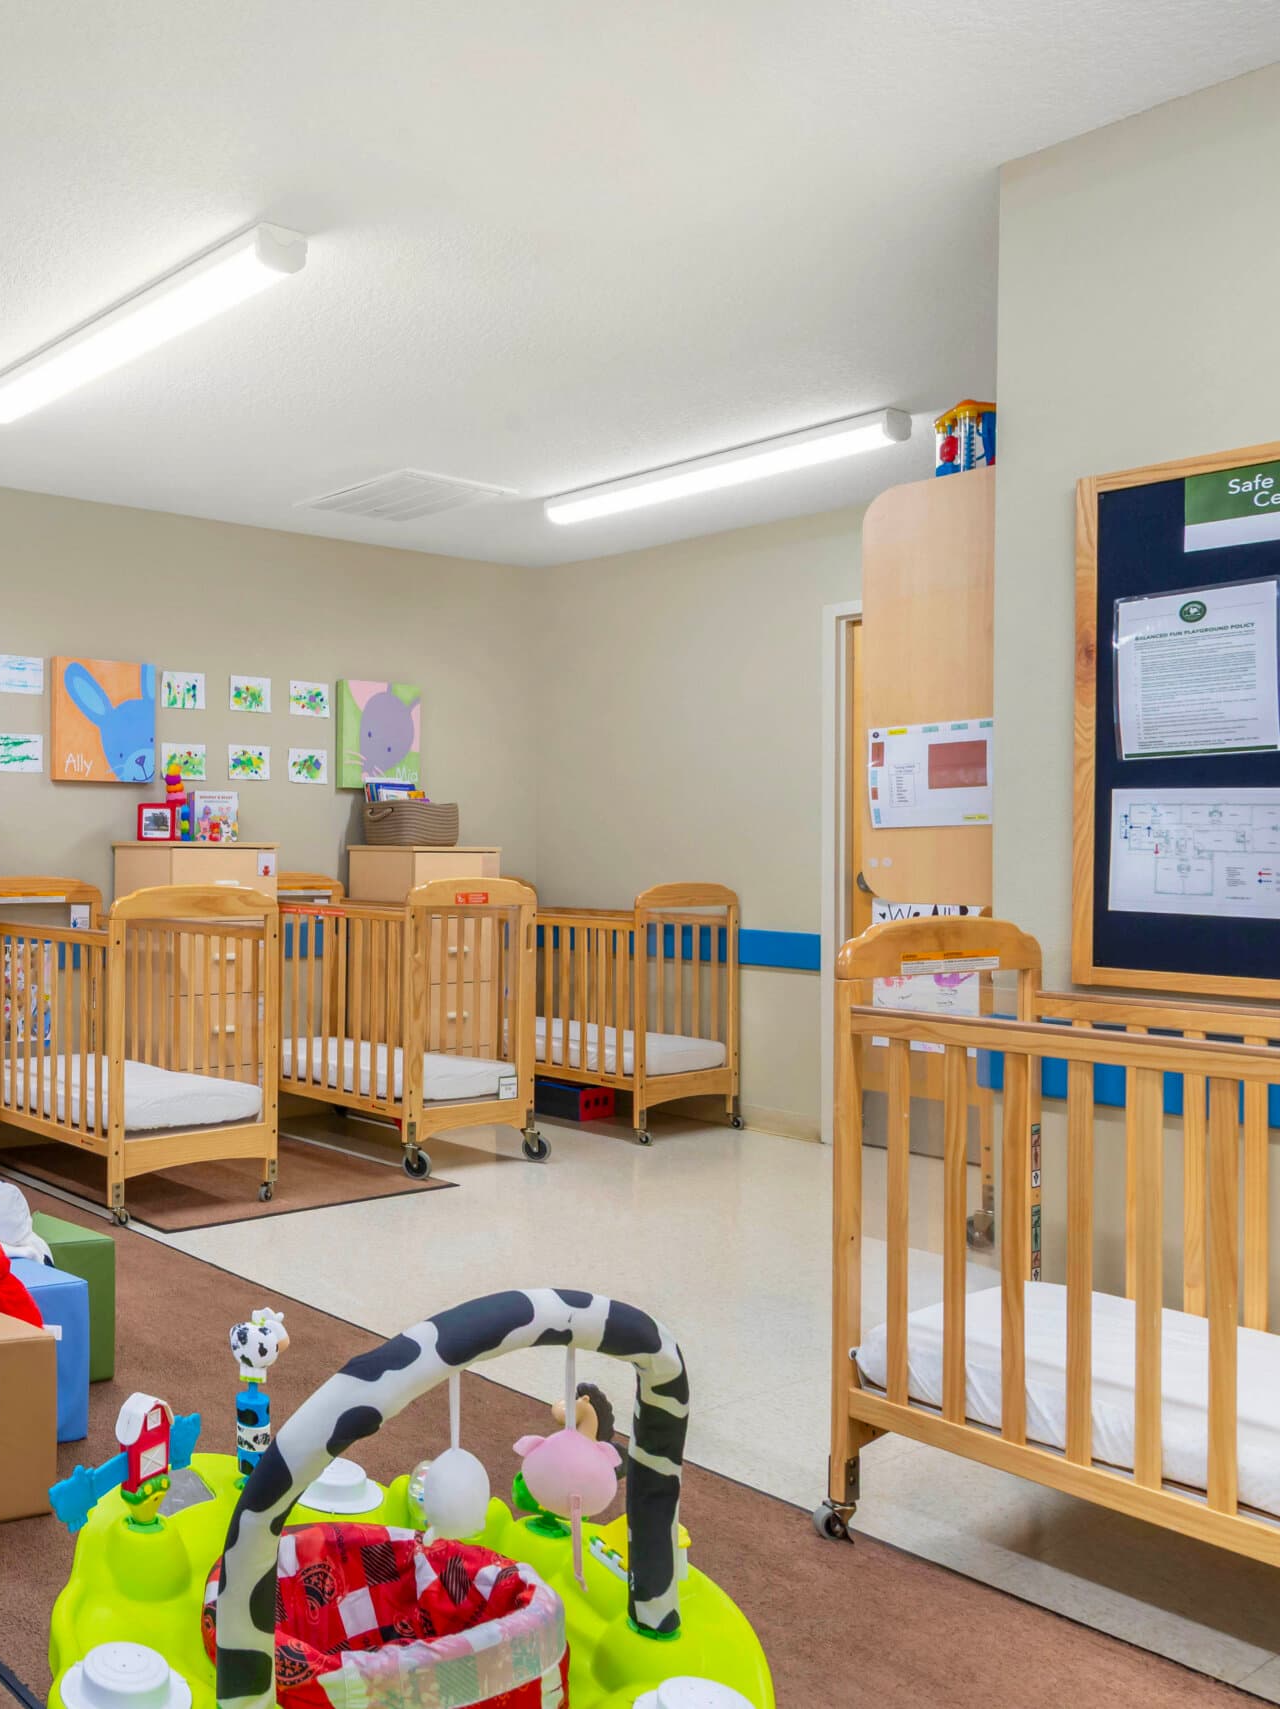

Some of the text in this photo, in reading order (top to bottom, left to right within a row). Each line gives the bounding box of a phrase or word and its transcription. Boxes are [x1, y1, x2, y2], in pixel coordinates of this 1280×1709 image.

[1228, 473, 1274, 494] Safe
[1184, 624, 1229, 635] PLAYGROUND
[1230, 621, 1255, 630] POLICY
[64, 752, 94, 777] Ally
